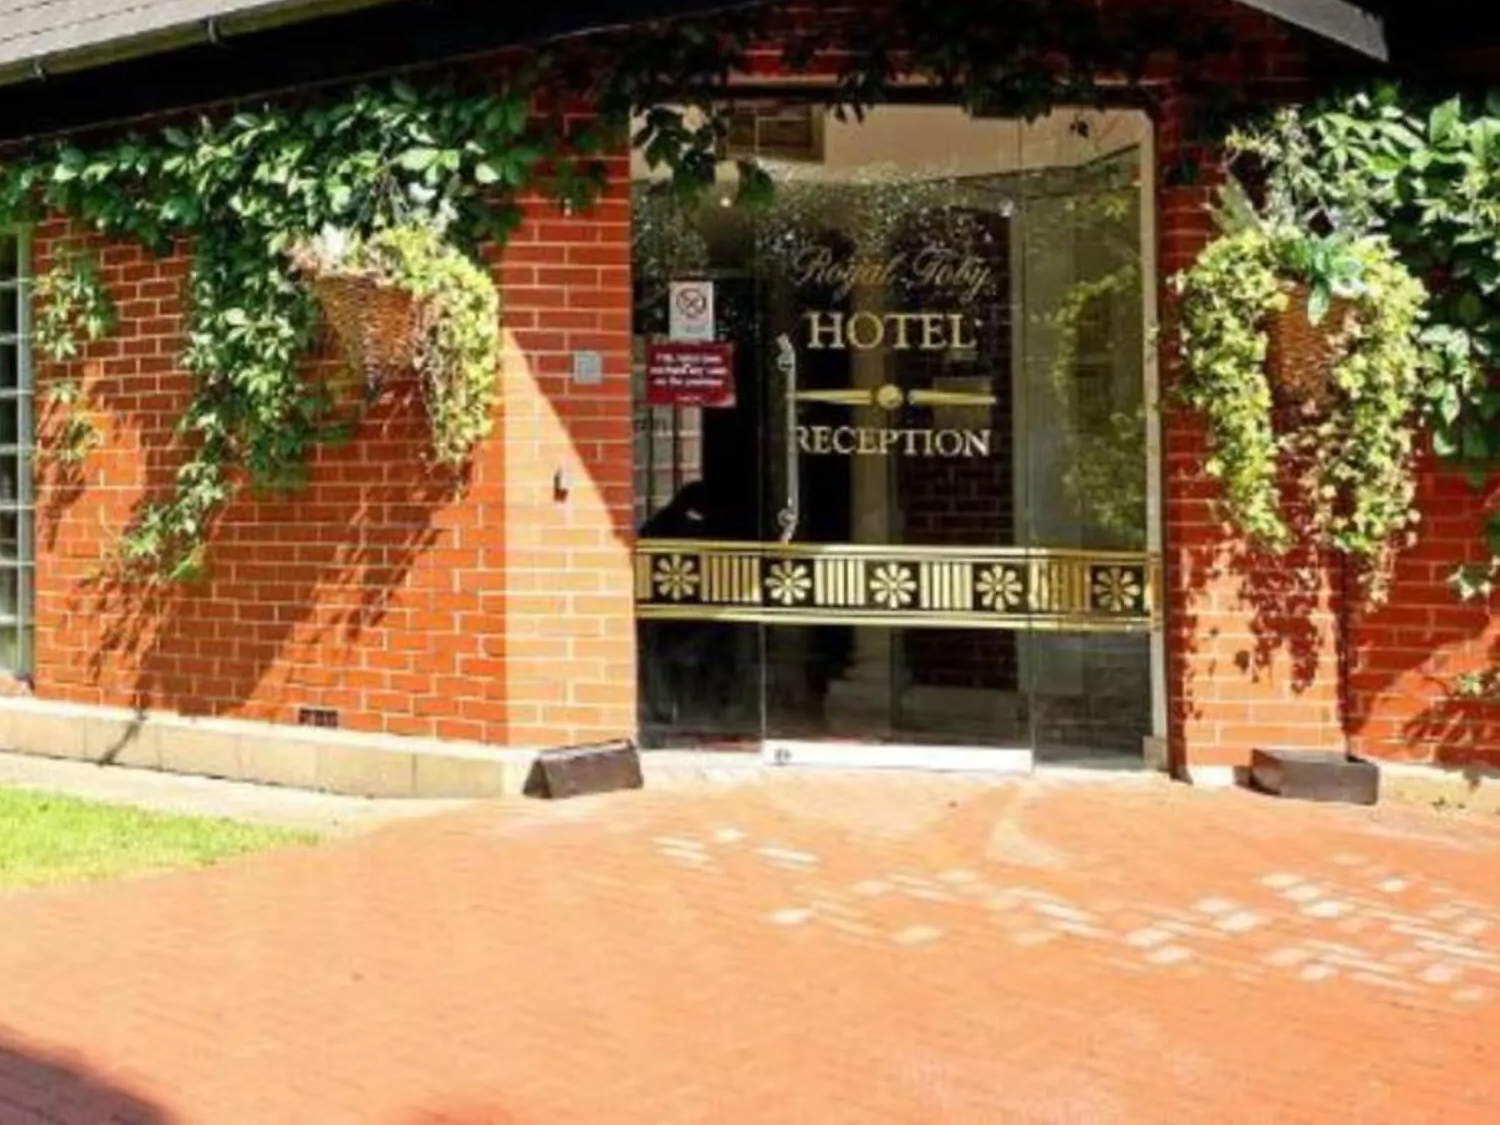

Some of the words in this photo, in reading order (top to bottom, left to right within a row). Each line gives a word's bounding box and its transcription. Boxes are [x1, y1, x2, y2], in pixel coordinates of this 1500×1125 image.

[792, 246, 905, 304] Royal
[804, 310, 977, 350] HOTEL
[795, 425, 991, 458] RECEPTION
